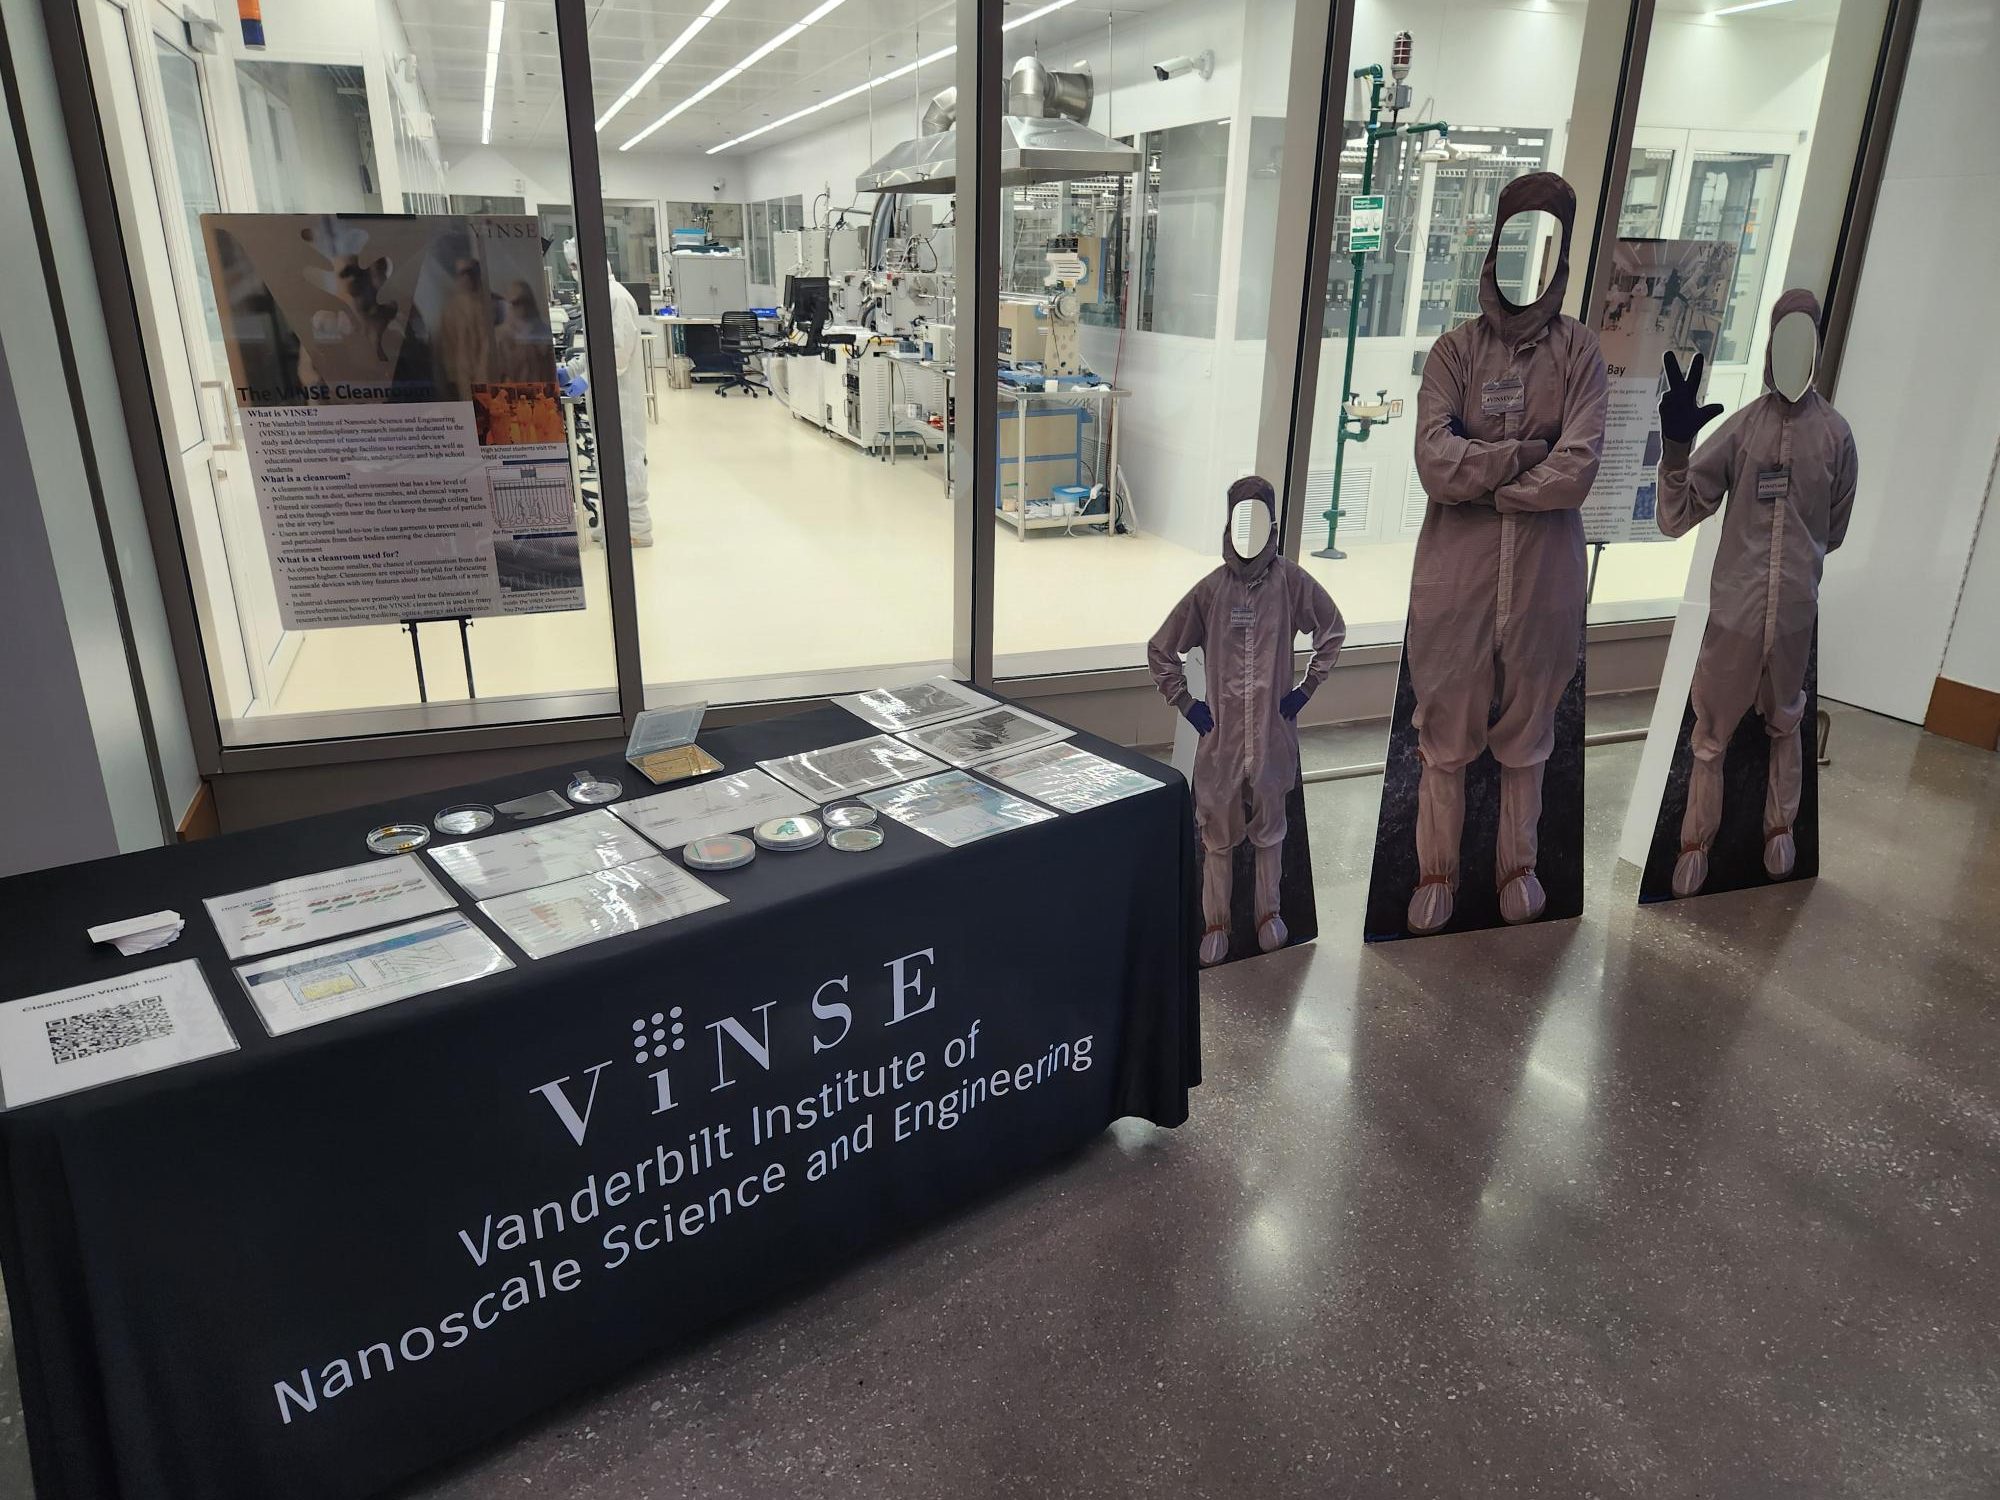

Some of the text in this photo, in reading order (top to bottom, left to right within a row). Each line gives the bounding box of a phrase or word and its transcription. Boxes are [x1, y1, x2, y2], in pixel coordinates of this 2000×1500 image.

[1607, 364, 1626, 377] Bay
[237, 386, 272, 402] The
[276, 385, 330, 401] VINSE
[248, 408, 318, 418] What is VINSE?
[262, 447, 287, 455] VINSE
[260, 474, 285, 483] What
[286, 474, 294, 482] is
[303, 472, 350, 481] cleanroom?
[276, 554, 300, 564] What
[302, 554, 309, 562] is
[317, 551, 361, 561] cleanroom
[362, 550, 381, 559] used
[382, 548, 398, 558] for?
[21, 993, 95, 1012] Cleanroom
[97, 981, 140, 995] Virtual
[459, 1019, 981, 1266] Vanderbilt Institute of
[274, 1035, 1093, 1424] Nanoscale Science and Engineering
